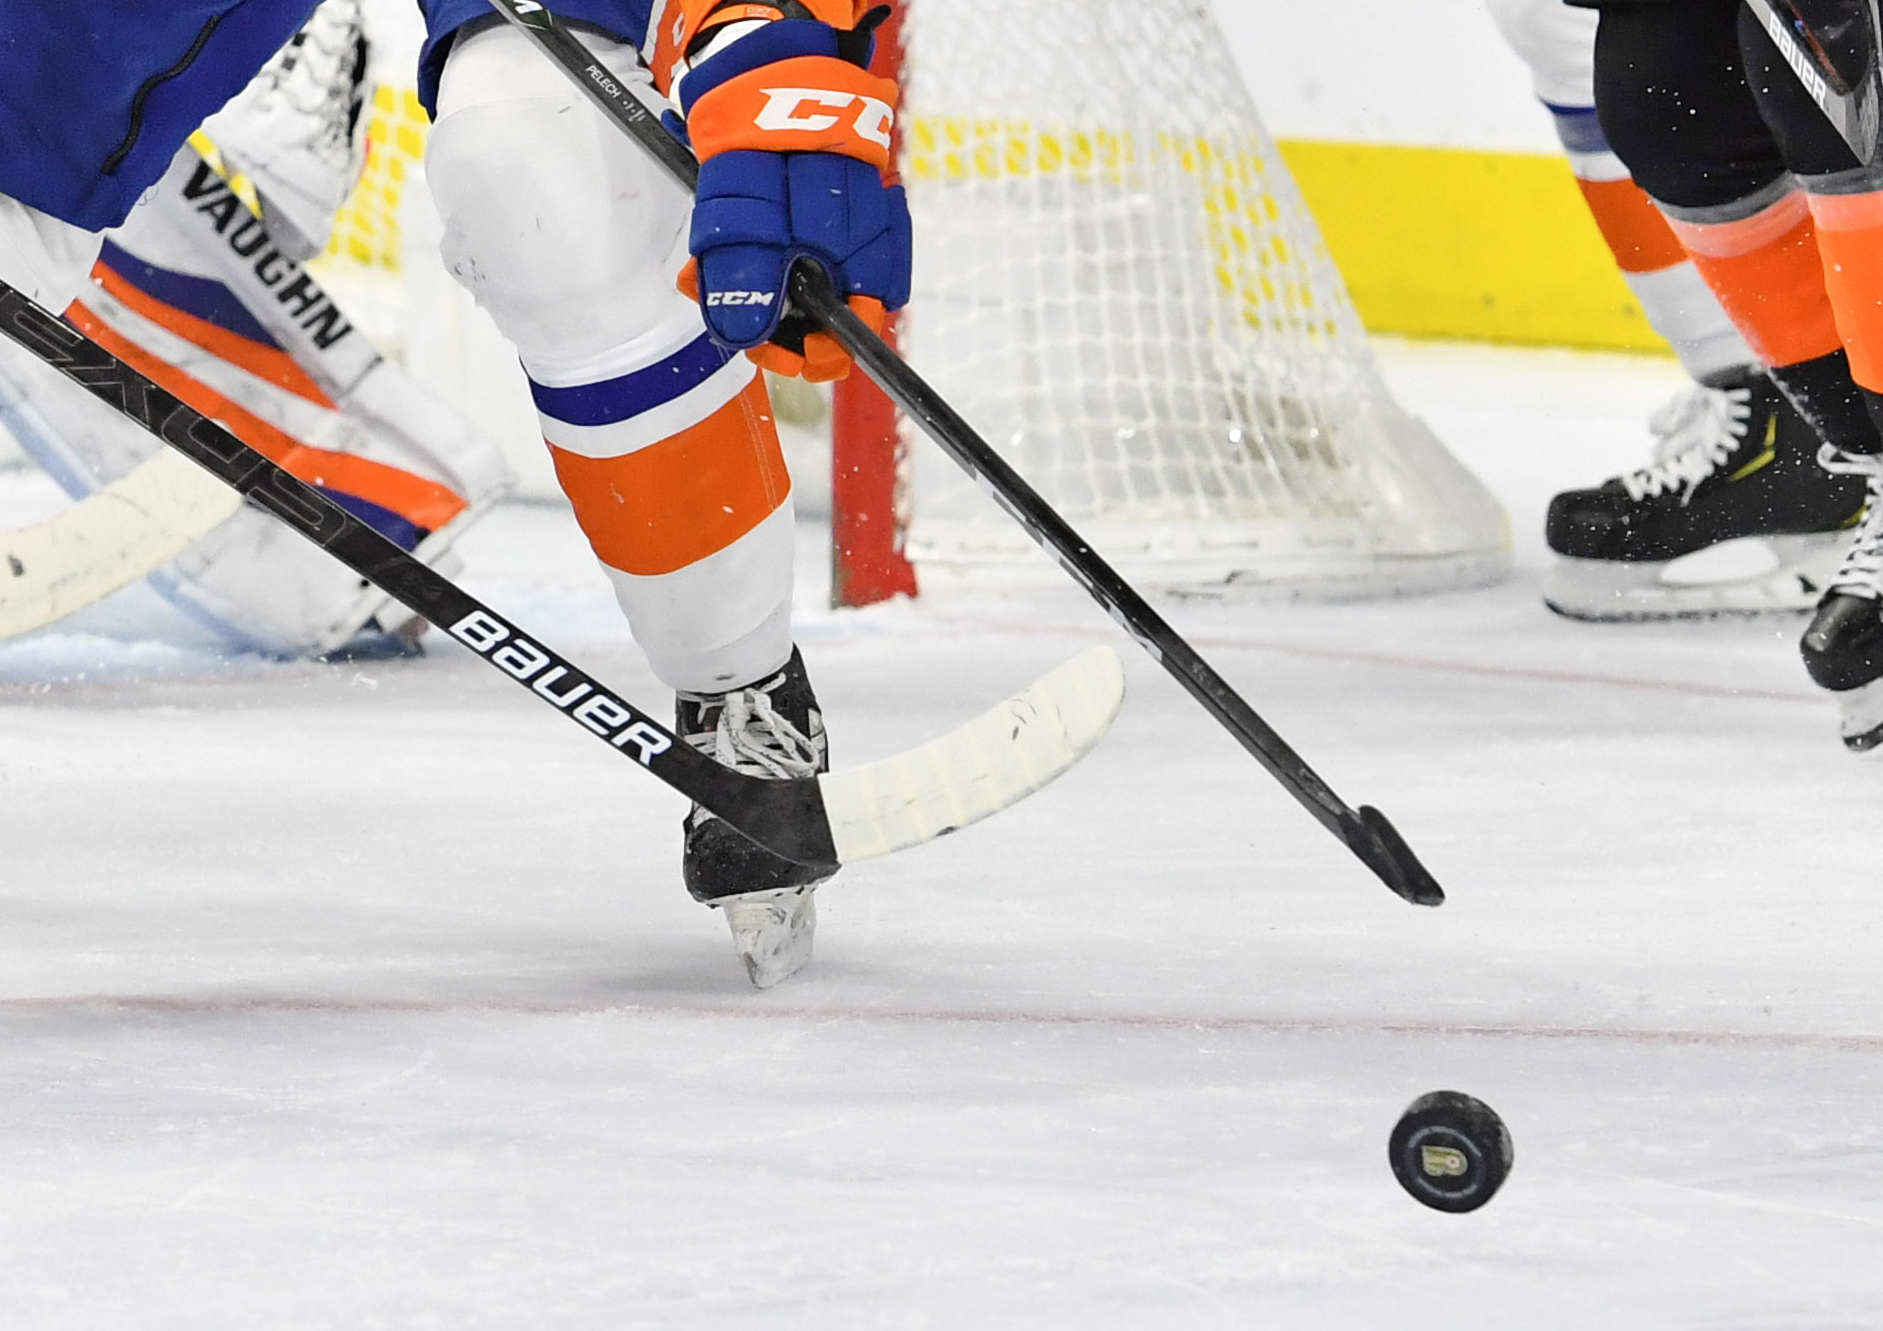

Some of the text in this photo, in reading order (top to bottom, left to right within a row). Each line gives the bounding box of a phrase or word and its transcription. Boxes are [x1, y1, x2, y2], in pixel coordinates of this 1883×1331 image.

[585, 64, 622, 99] PELECH
[183, 159, 353, 351] VAUGHN
[706, 291, 775, 307] CCM
